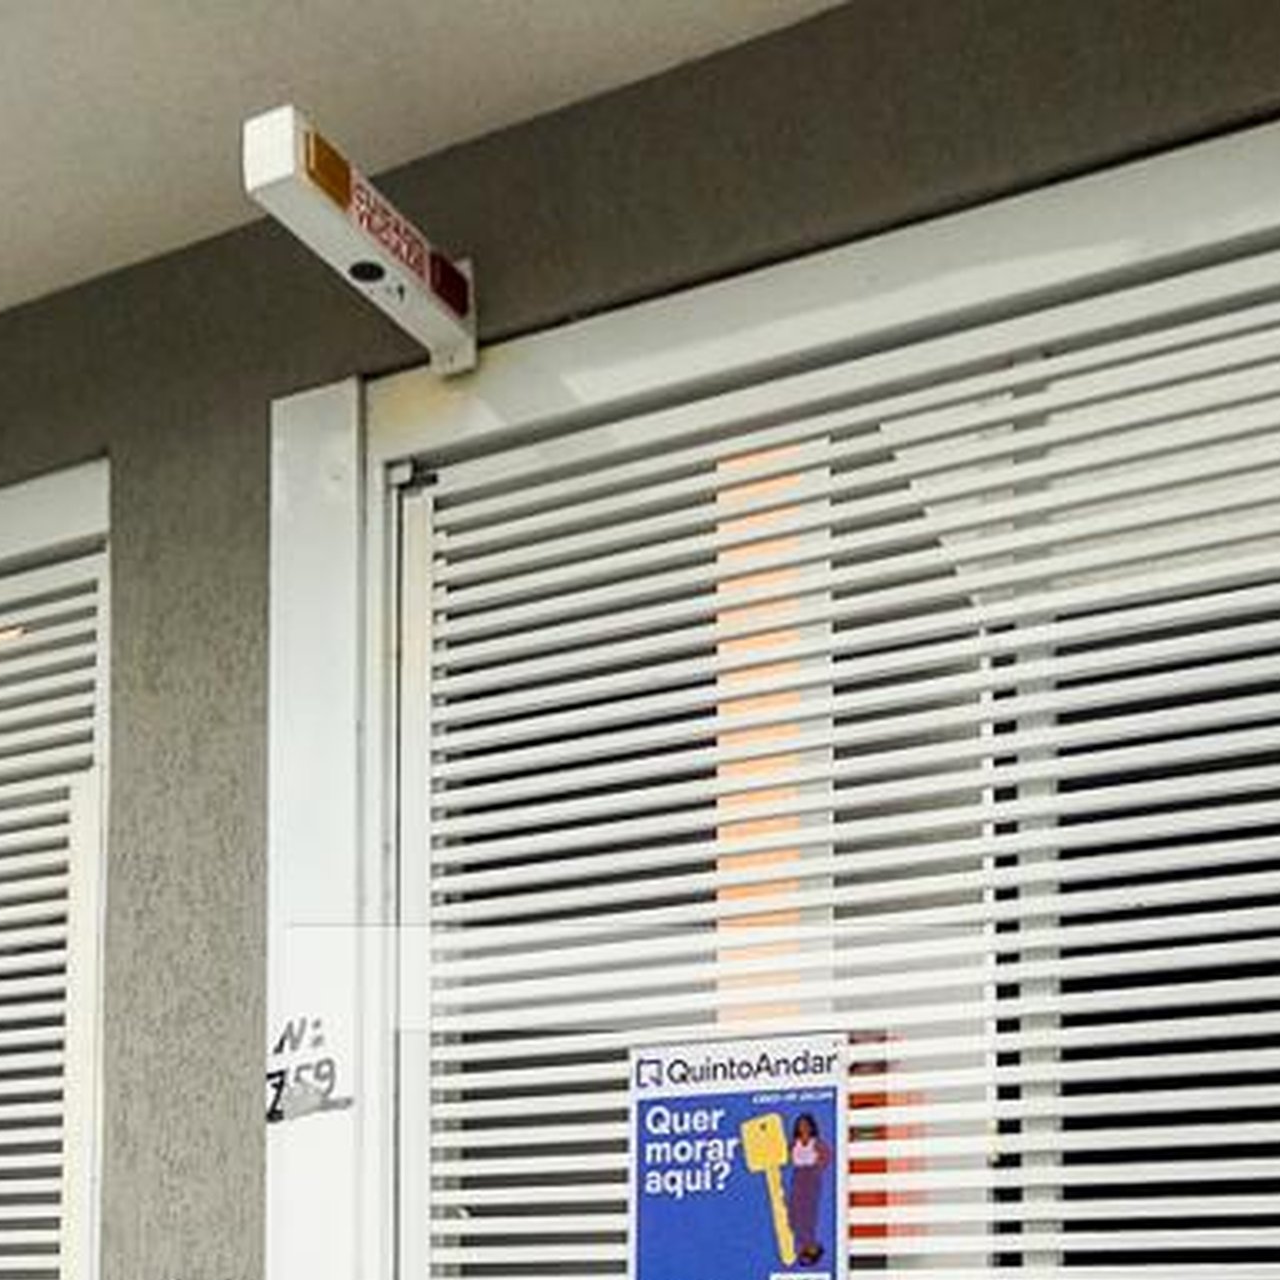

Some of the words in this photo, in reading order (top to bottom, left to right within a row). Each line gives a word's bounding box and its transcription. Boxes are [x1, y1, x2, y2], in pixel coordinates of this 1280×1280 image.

[667, 1051, 838, 1085] QuintoAndar
[646, 1105, 726, 1135] Quer
[646, 1138, 738, 1164] morar
[646, 1161, 731, 1199] aqui?
